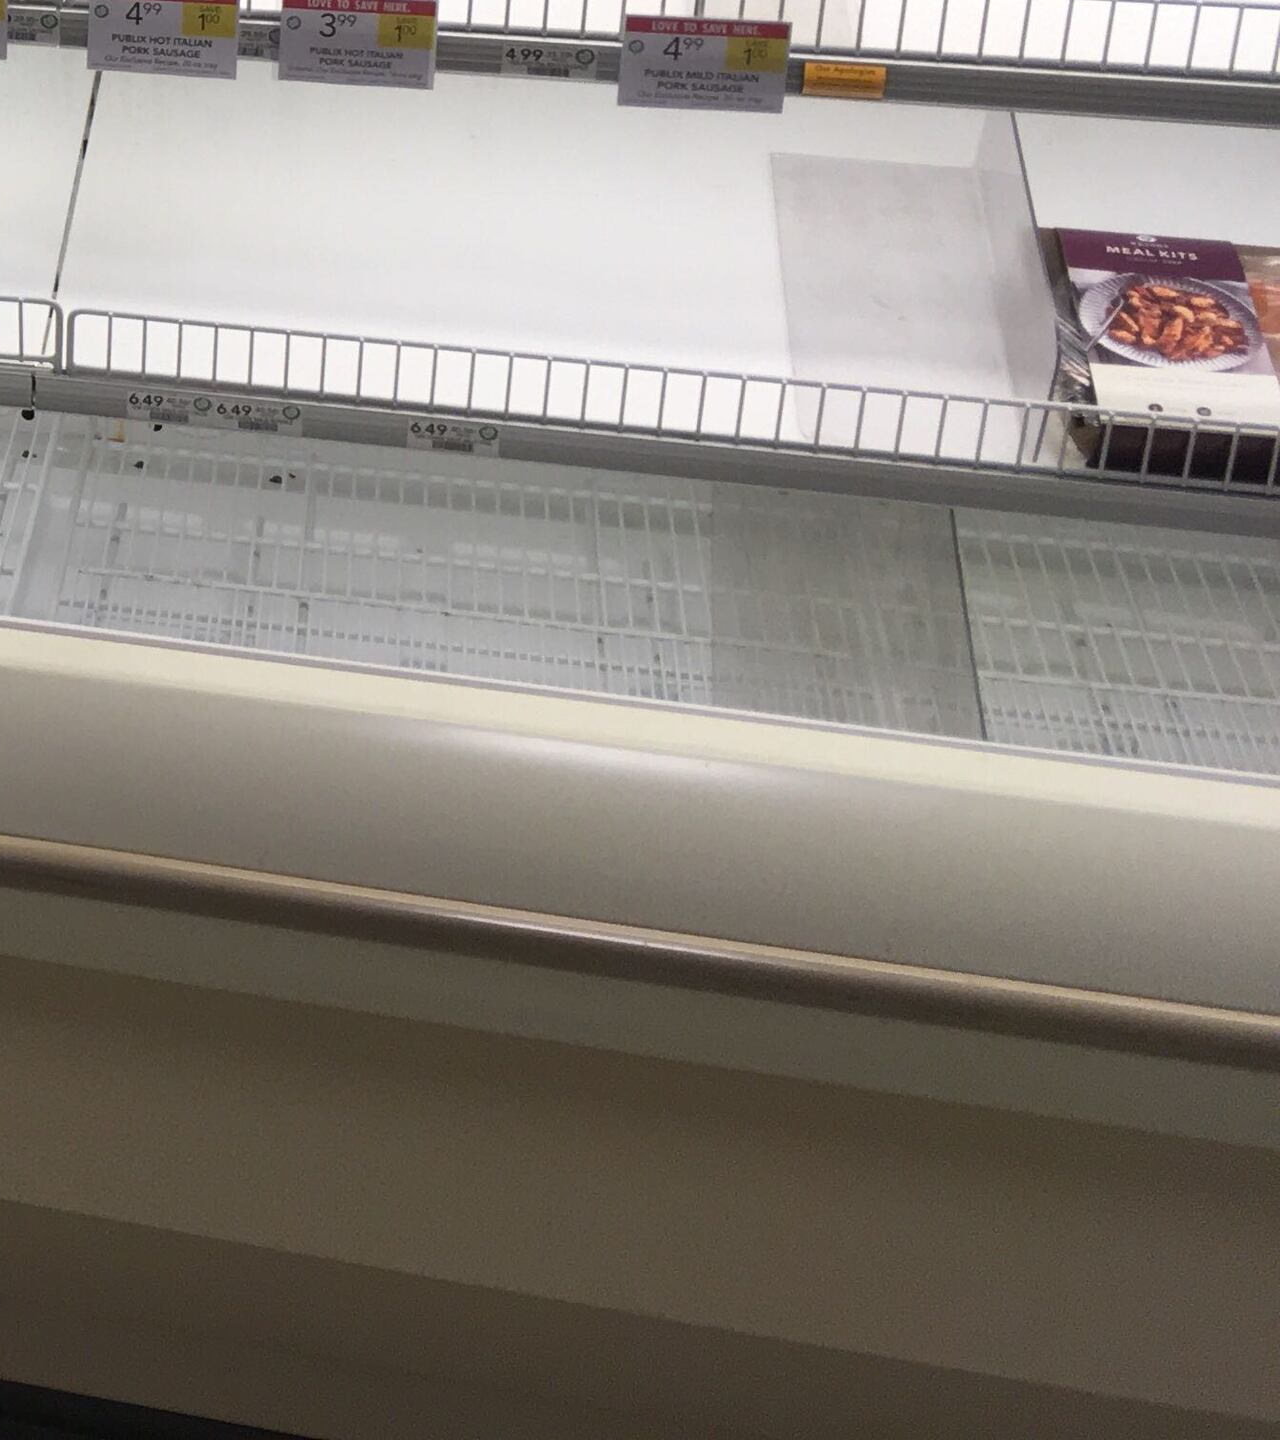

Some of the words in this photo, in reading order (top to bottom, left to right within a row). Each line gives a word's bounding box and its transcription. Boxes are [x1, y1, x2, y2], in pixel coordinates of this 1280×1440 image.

[354, 0, 378, 11] SAVE
[383, 1, 411, 13] HERE.
[651, 20, 678, 32] LOVE
[683, 21, 697, 32] TO
[702, 22, 727, 33] SAVE
[733, 23, 761, 35] HERE.
[111, 33, 146, 44] PUBLIX
[149, 35, 170, 45] HOT
[173, 37, 213, 48] ITALIAN
[122, 45, 150, 56] PORK
[152, 47, 201, 59] SAUSAGE
[1106, 245, 1155, 257] MEAL
[1158, 249, 1198, 261] KITS
